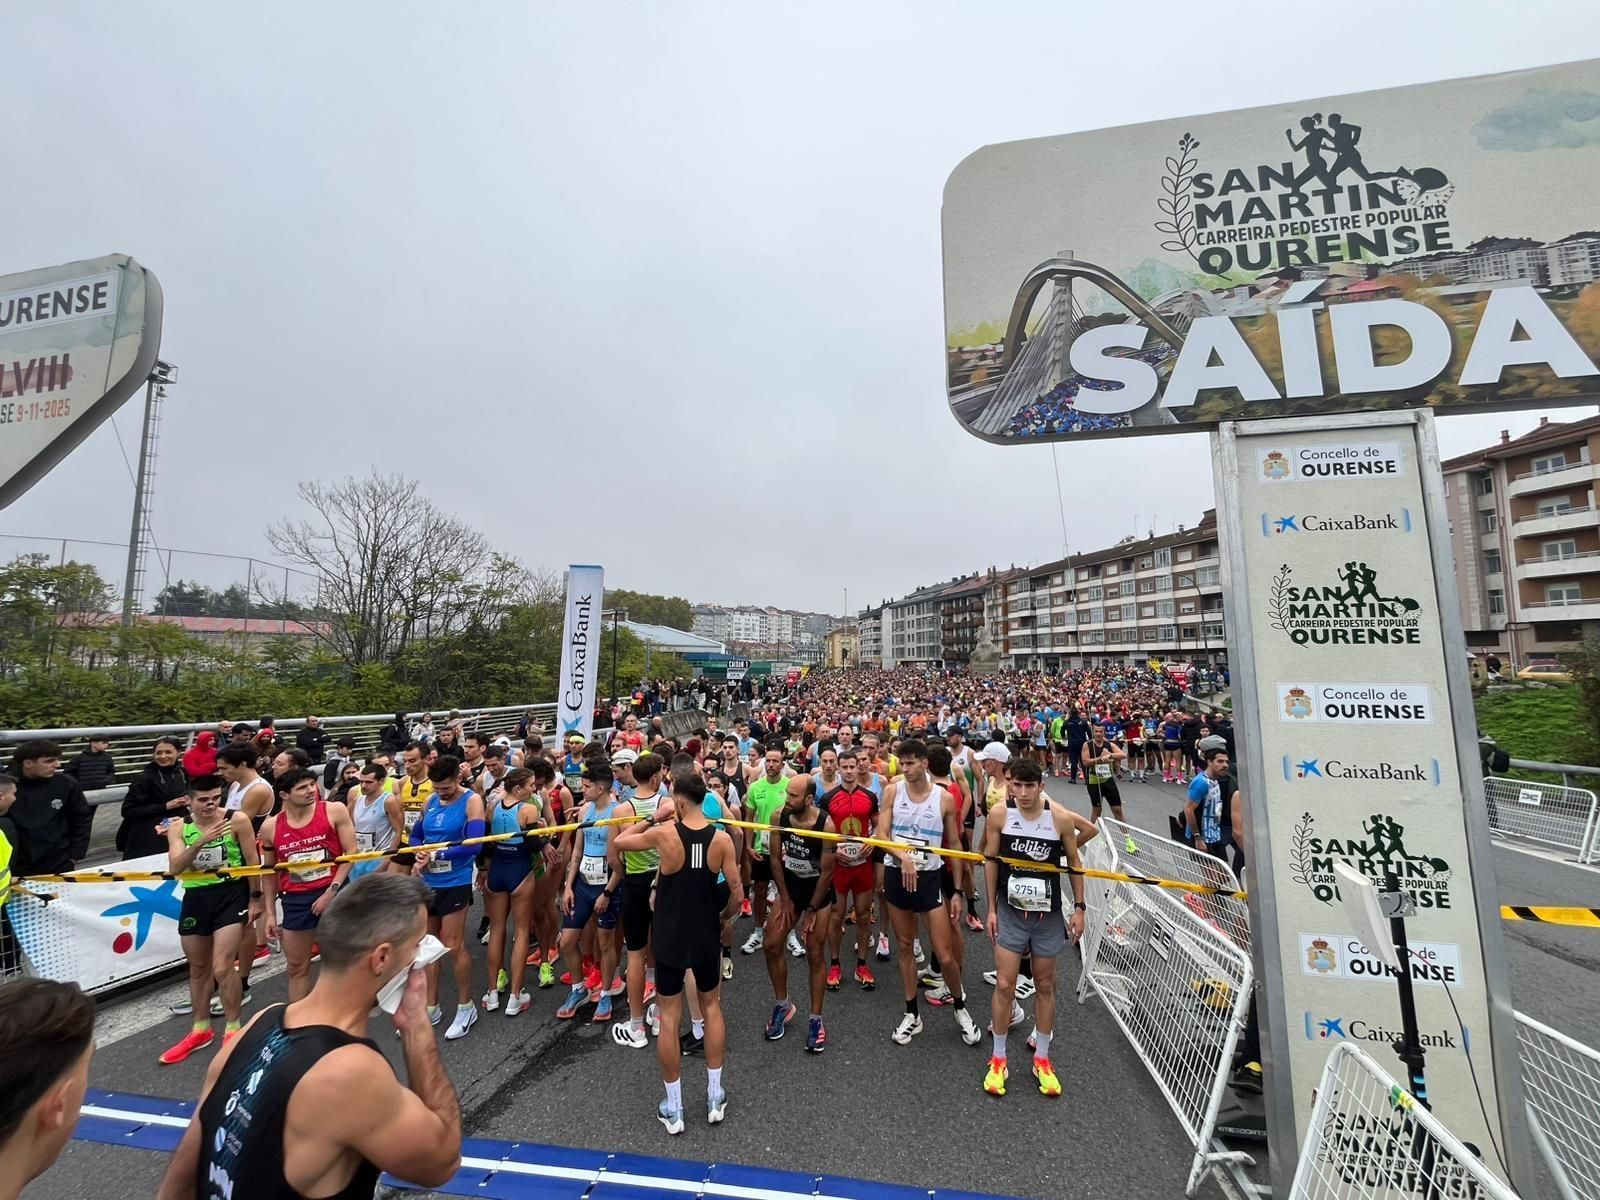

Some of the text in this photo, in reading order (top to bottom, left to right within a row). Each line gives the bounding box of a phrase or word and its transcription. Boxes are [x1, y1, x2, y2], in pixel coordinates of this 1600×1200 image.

[1192, 162, 1296, 199] SAN
[1195, 180, 1407, 229] MARTIN
[1196, 205, 1448, 246] CARREIRA PEDESTRE POPULAR
[1198, 221, 1453, 275] OURENSE
[1069, 279, 1599, 414] SAÍDA
[17, 398, 71, 422] 9-11-2025
[1300, 447, 1380, 460] Concello de
[1301, 459, 1397, 477] OURENSE
[1301, 513, 1399, 532] CaixaBank
[1288, 586, 1344, 601] SAN
[1289, 602, 1397, 619] MARTIN
[1290, 618, 1418, 628] CARREIRA PEDESTRE POPULAR
[1291, 628, 1421, 645] OURENSE
[565, 593, 592, 712] CaixaBank
[1323, 688, 1407, 701] Concello de
[1324, 704, 1425, 720] OURENSE
[1324, 761, 1428, 781] CaixaBank
[279, 834, 326, 850] ALEX TEAM
[1011, 838, 1052, 855] delikia
[1310, 838, 1368, 856] SAN
[584, 862, 595, 871] 721
[1312, 856, 1427, 878] MRTIN
[1014, 884, 1037, 896] 9751
[1405, 880, 1448, 890] POPULAR
[1419, 947, 1436, 960] de
[1349, 959, 1456, 982] OURNSE
[1349, 1020, 1456, 1048] Caixaank
